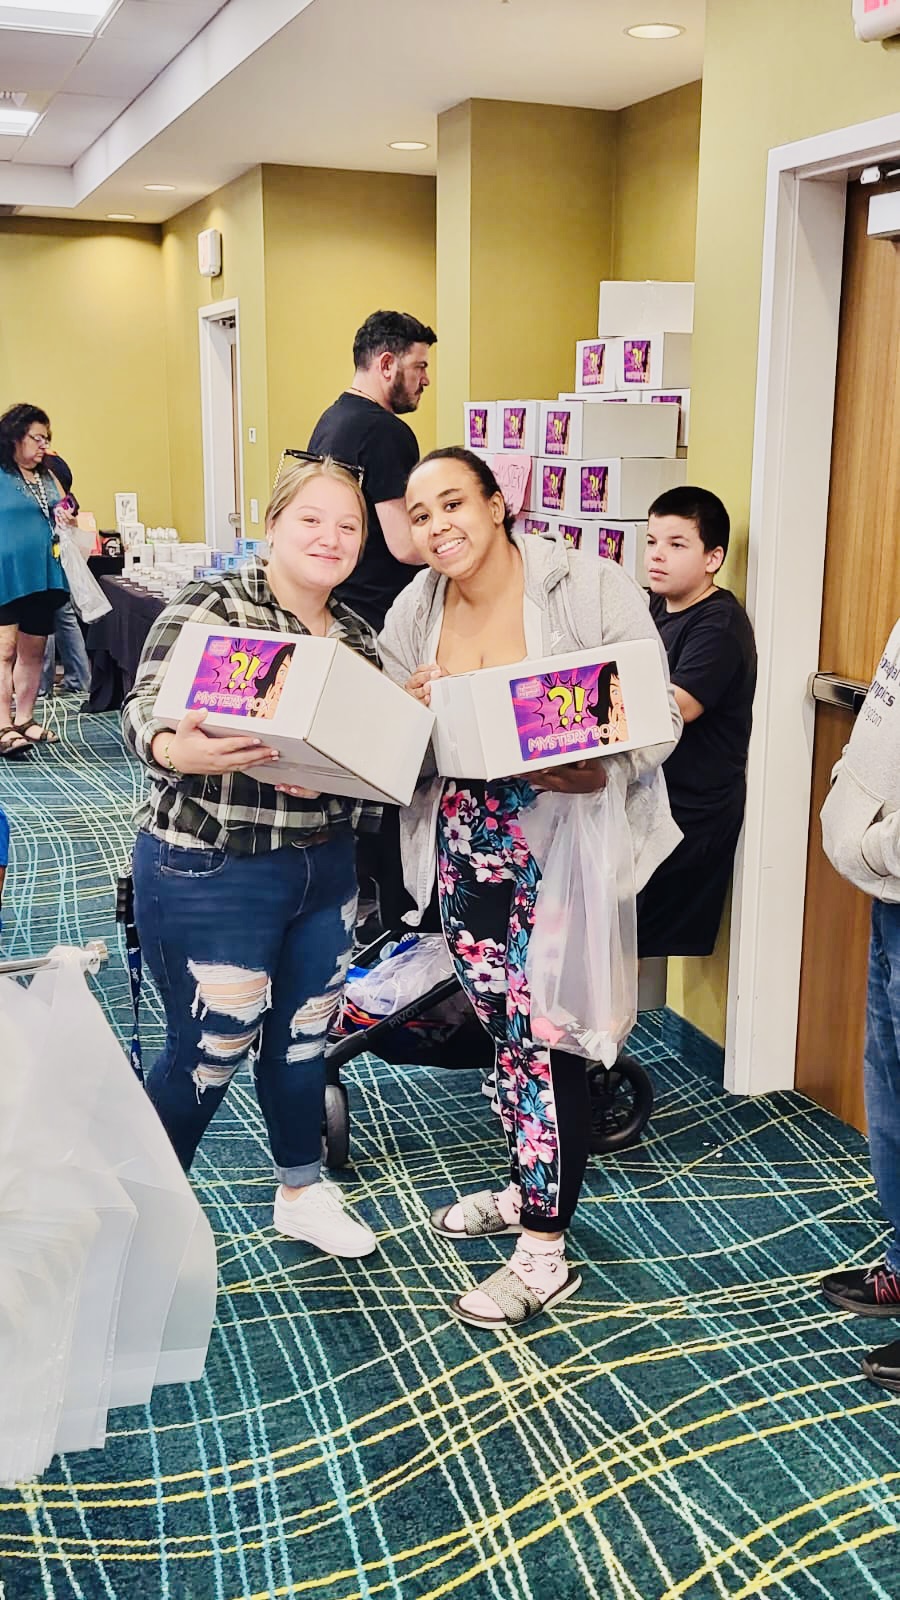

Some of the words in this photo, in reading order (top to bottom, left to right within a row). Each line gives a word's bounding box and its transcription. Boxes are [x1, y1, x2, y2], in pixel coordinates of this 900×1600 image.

[193, 690, 245, 709] MYSTERY
[245, 695, 270, 711] BOX
[527, 727, 590, 753] MYSTERY
[591, 722, 621, 741] BOX
